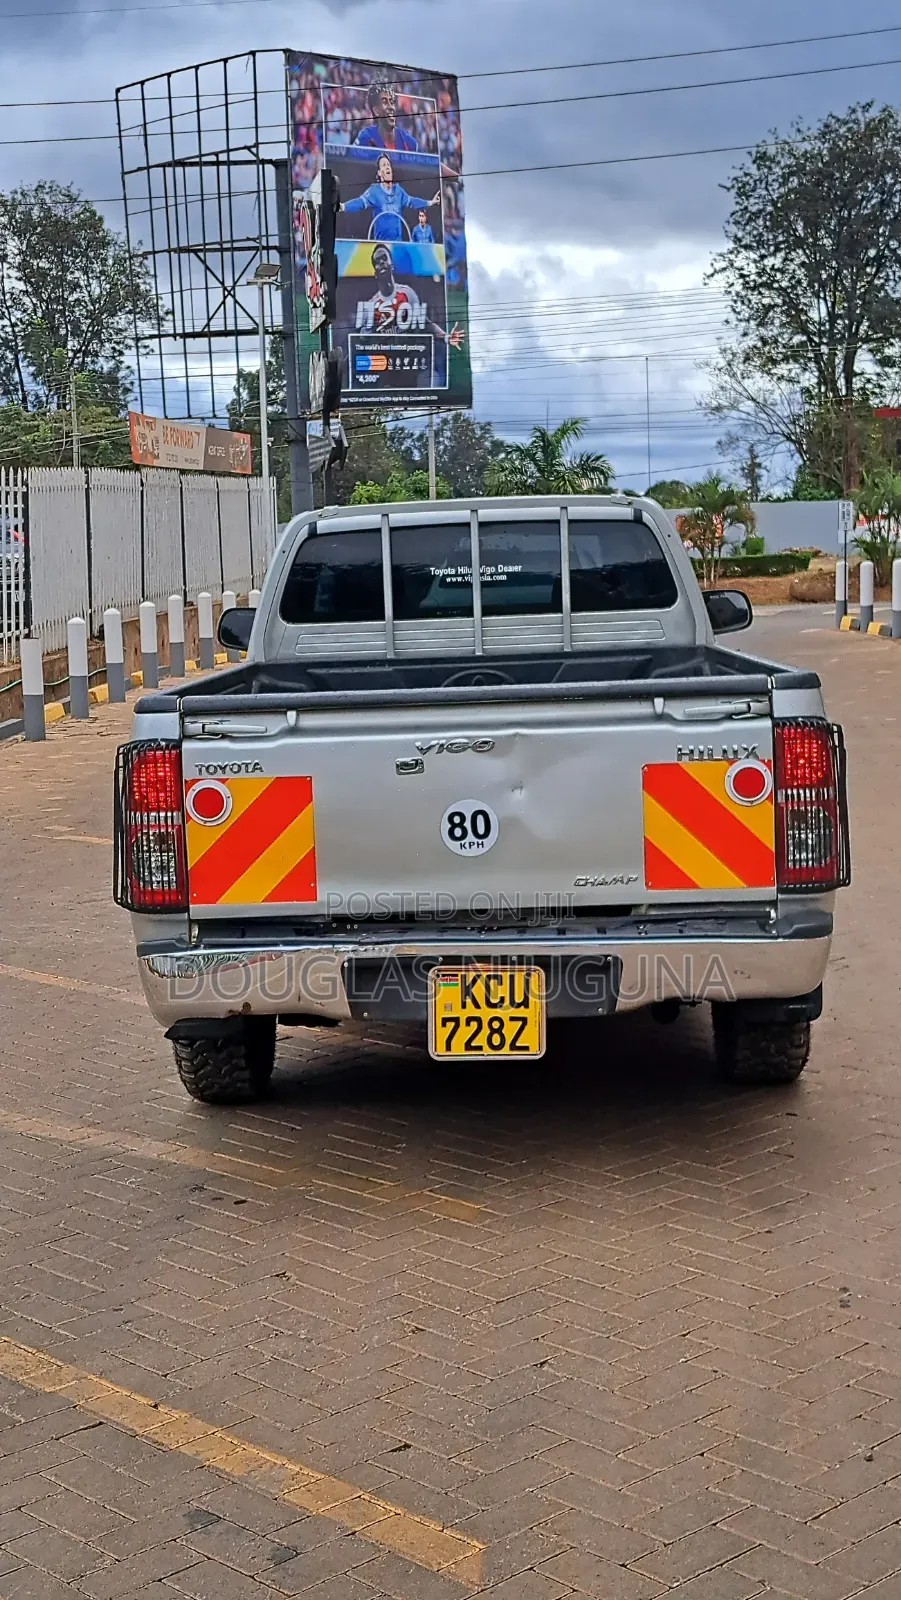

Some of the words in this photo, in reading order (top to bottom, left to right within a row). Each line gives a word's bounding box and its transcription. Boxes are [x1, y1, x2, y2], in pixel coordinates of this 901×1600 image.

[397, 302, 427, 329] ON
[169, 426, 194, 449] FORWARD
[430, 567, 456, 577] Toyota
[457, 566, 473, 575] Hilu
[414, 737, 496, 756] VIGO
[676, 743, 760, 762] HILUX
[194, 759, 265, 776] TOYOTA
[446, 808, 492, 843] 80
[459, 841, 485, 850] KPH
[573, 875, 639, 888] CHAMP
[460, 973, 530, 1009] KCU
[441, 1016, 530, 1052] 728Z
